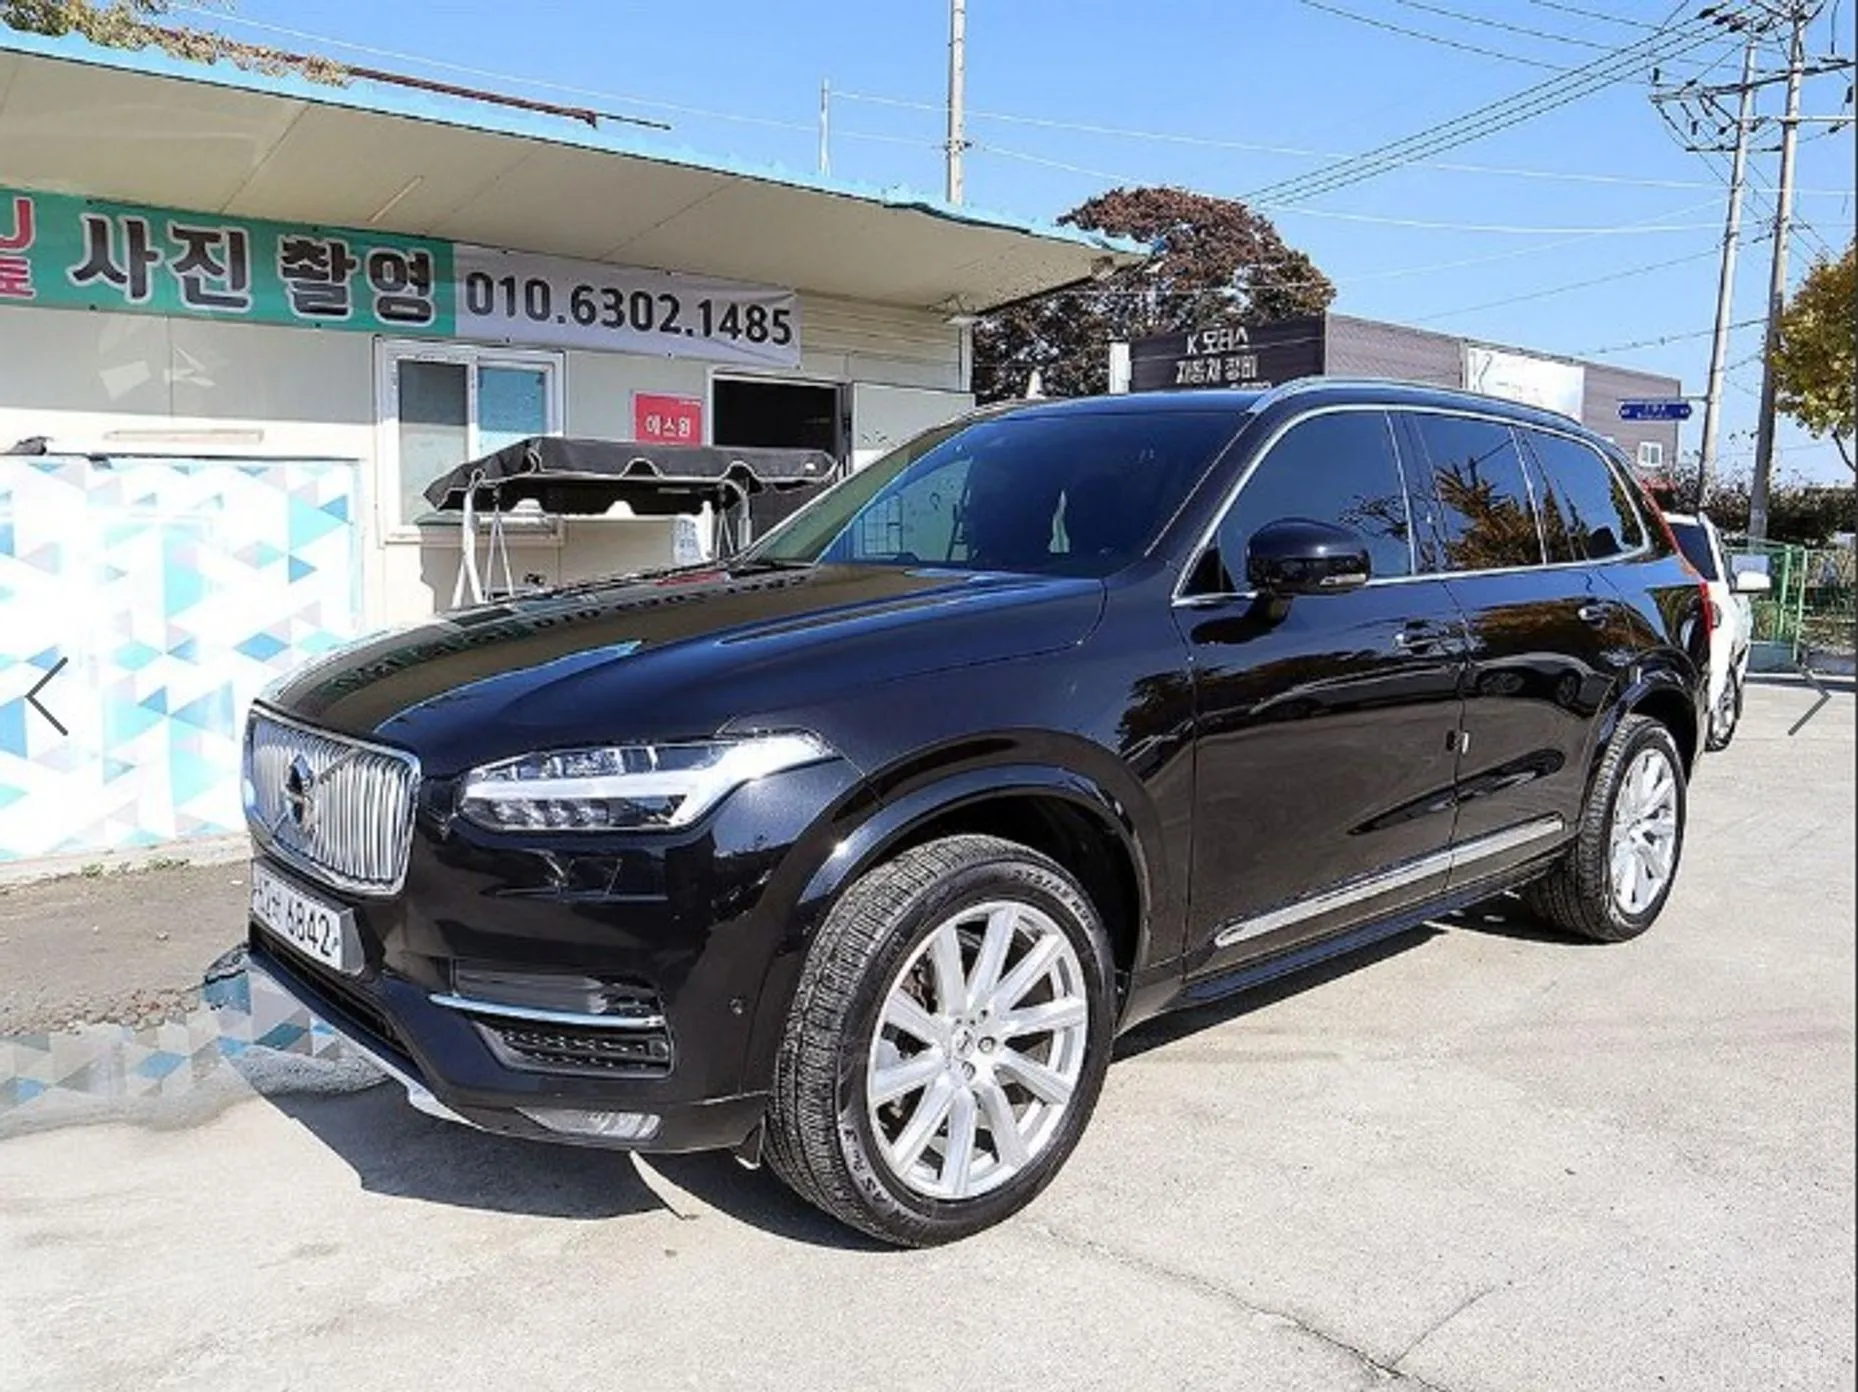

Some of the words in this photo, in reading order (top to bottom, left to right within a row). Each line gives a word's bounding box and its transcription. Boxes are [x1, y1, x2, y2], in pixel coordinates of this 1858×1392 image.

[70, 214, 250, 311] 사진
[278, 235, 434, 325] 촬영
[465, 271, 793, 346] 010.6302.1485
[1187, 334, 1198, 354] K
[1202, 326, 1249, 354] 모터스
[1176, 357, 1221, 384] 자동차
